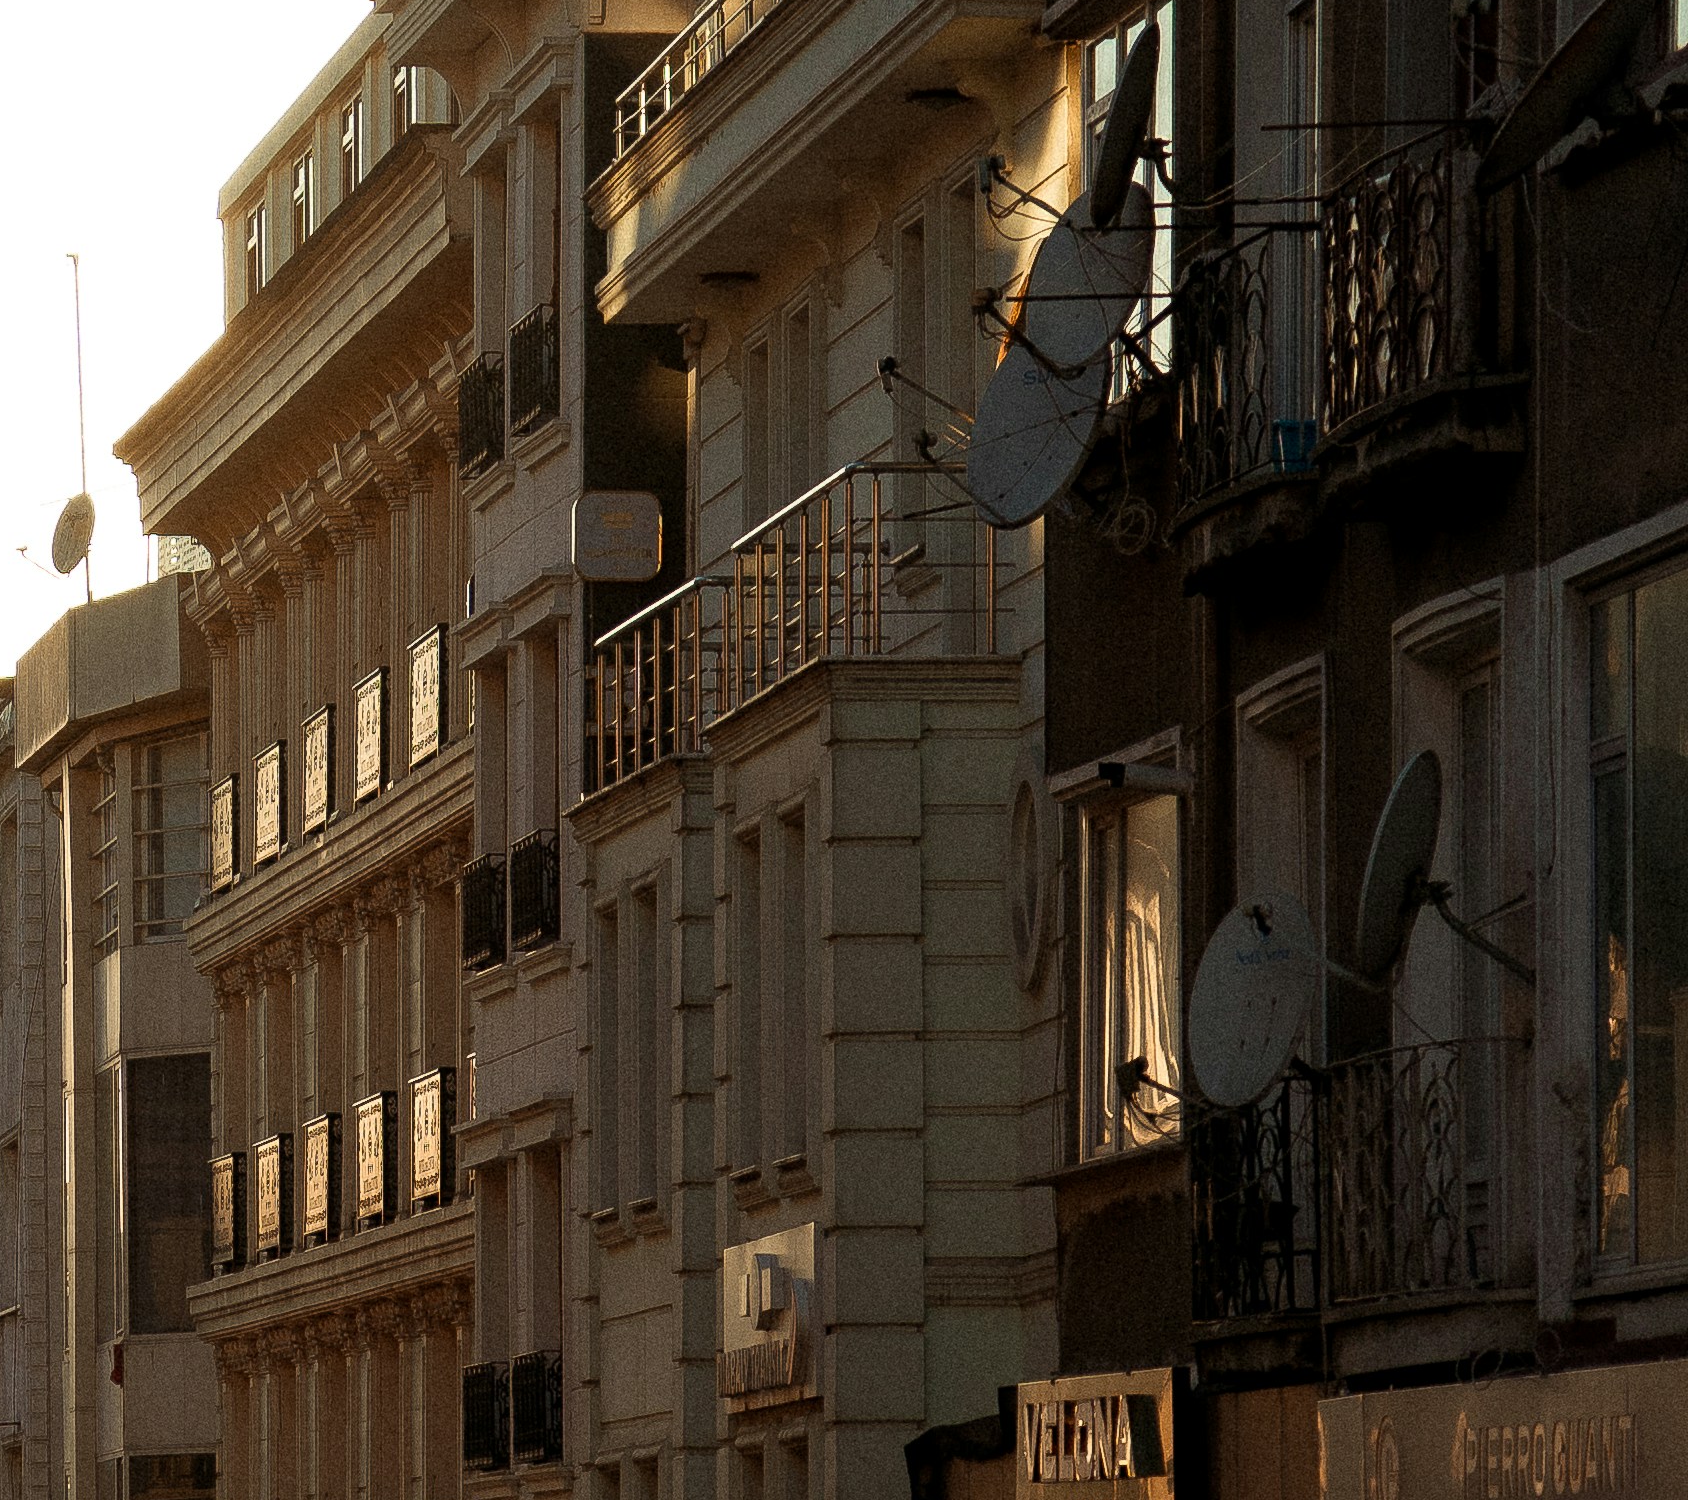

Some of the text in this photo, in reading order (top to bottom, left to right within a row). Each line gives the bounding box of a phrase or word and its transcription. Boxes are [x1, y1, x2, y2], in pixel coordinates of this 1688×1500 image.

[1023, 1393, 1137, 1482] VELONA
[1465, 1414, 1638, 1500] PIERRO GUANTI
